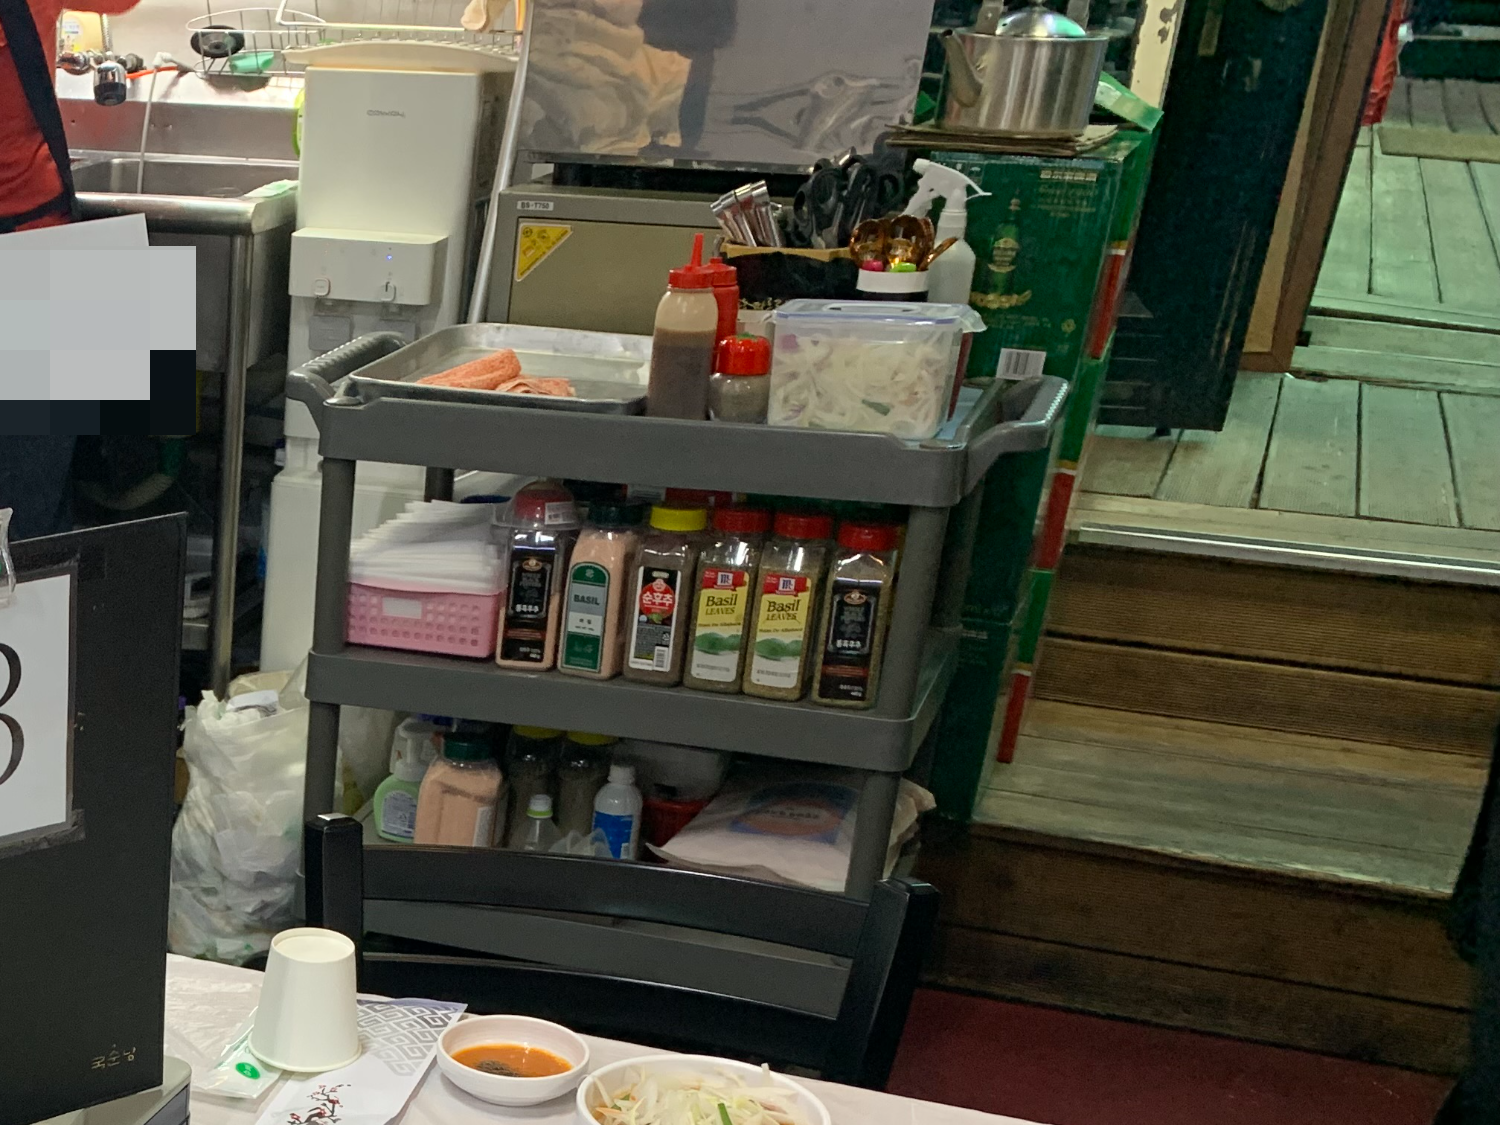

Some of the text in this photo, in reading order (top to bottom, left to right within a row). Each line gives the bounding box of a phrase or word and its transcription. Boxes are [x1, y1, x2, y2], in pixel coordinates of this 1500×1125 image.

[573, 593, 600, 606] BASIL
[641, 591, 674, 607] 순후추
[705, 594, 738, 607] Basil
[766, 599, 801, 612] Basil
[705, 607, 736, 616] LEAVES
[766, 612, 798, 621] LEAVES
